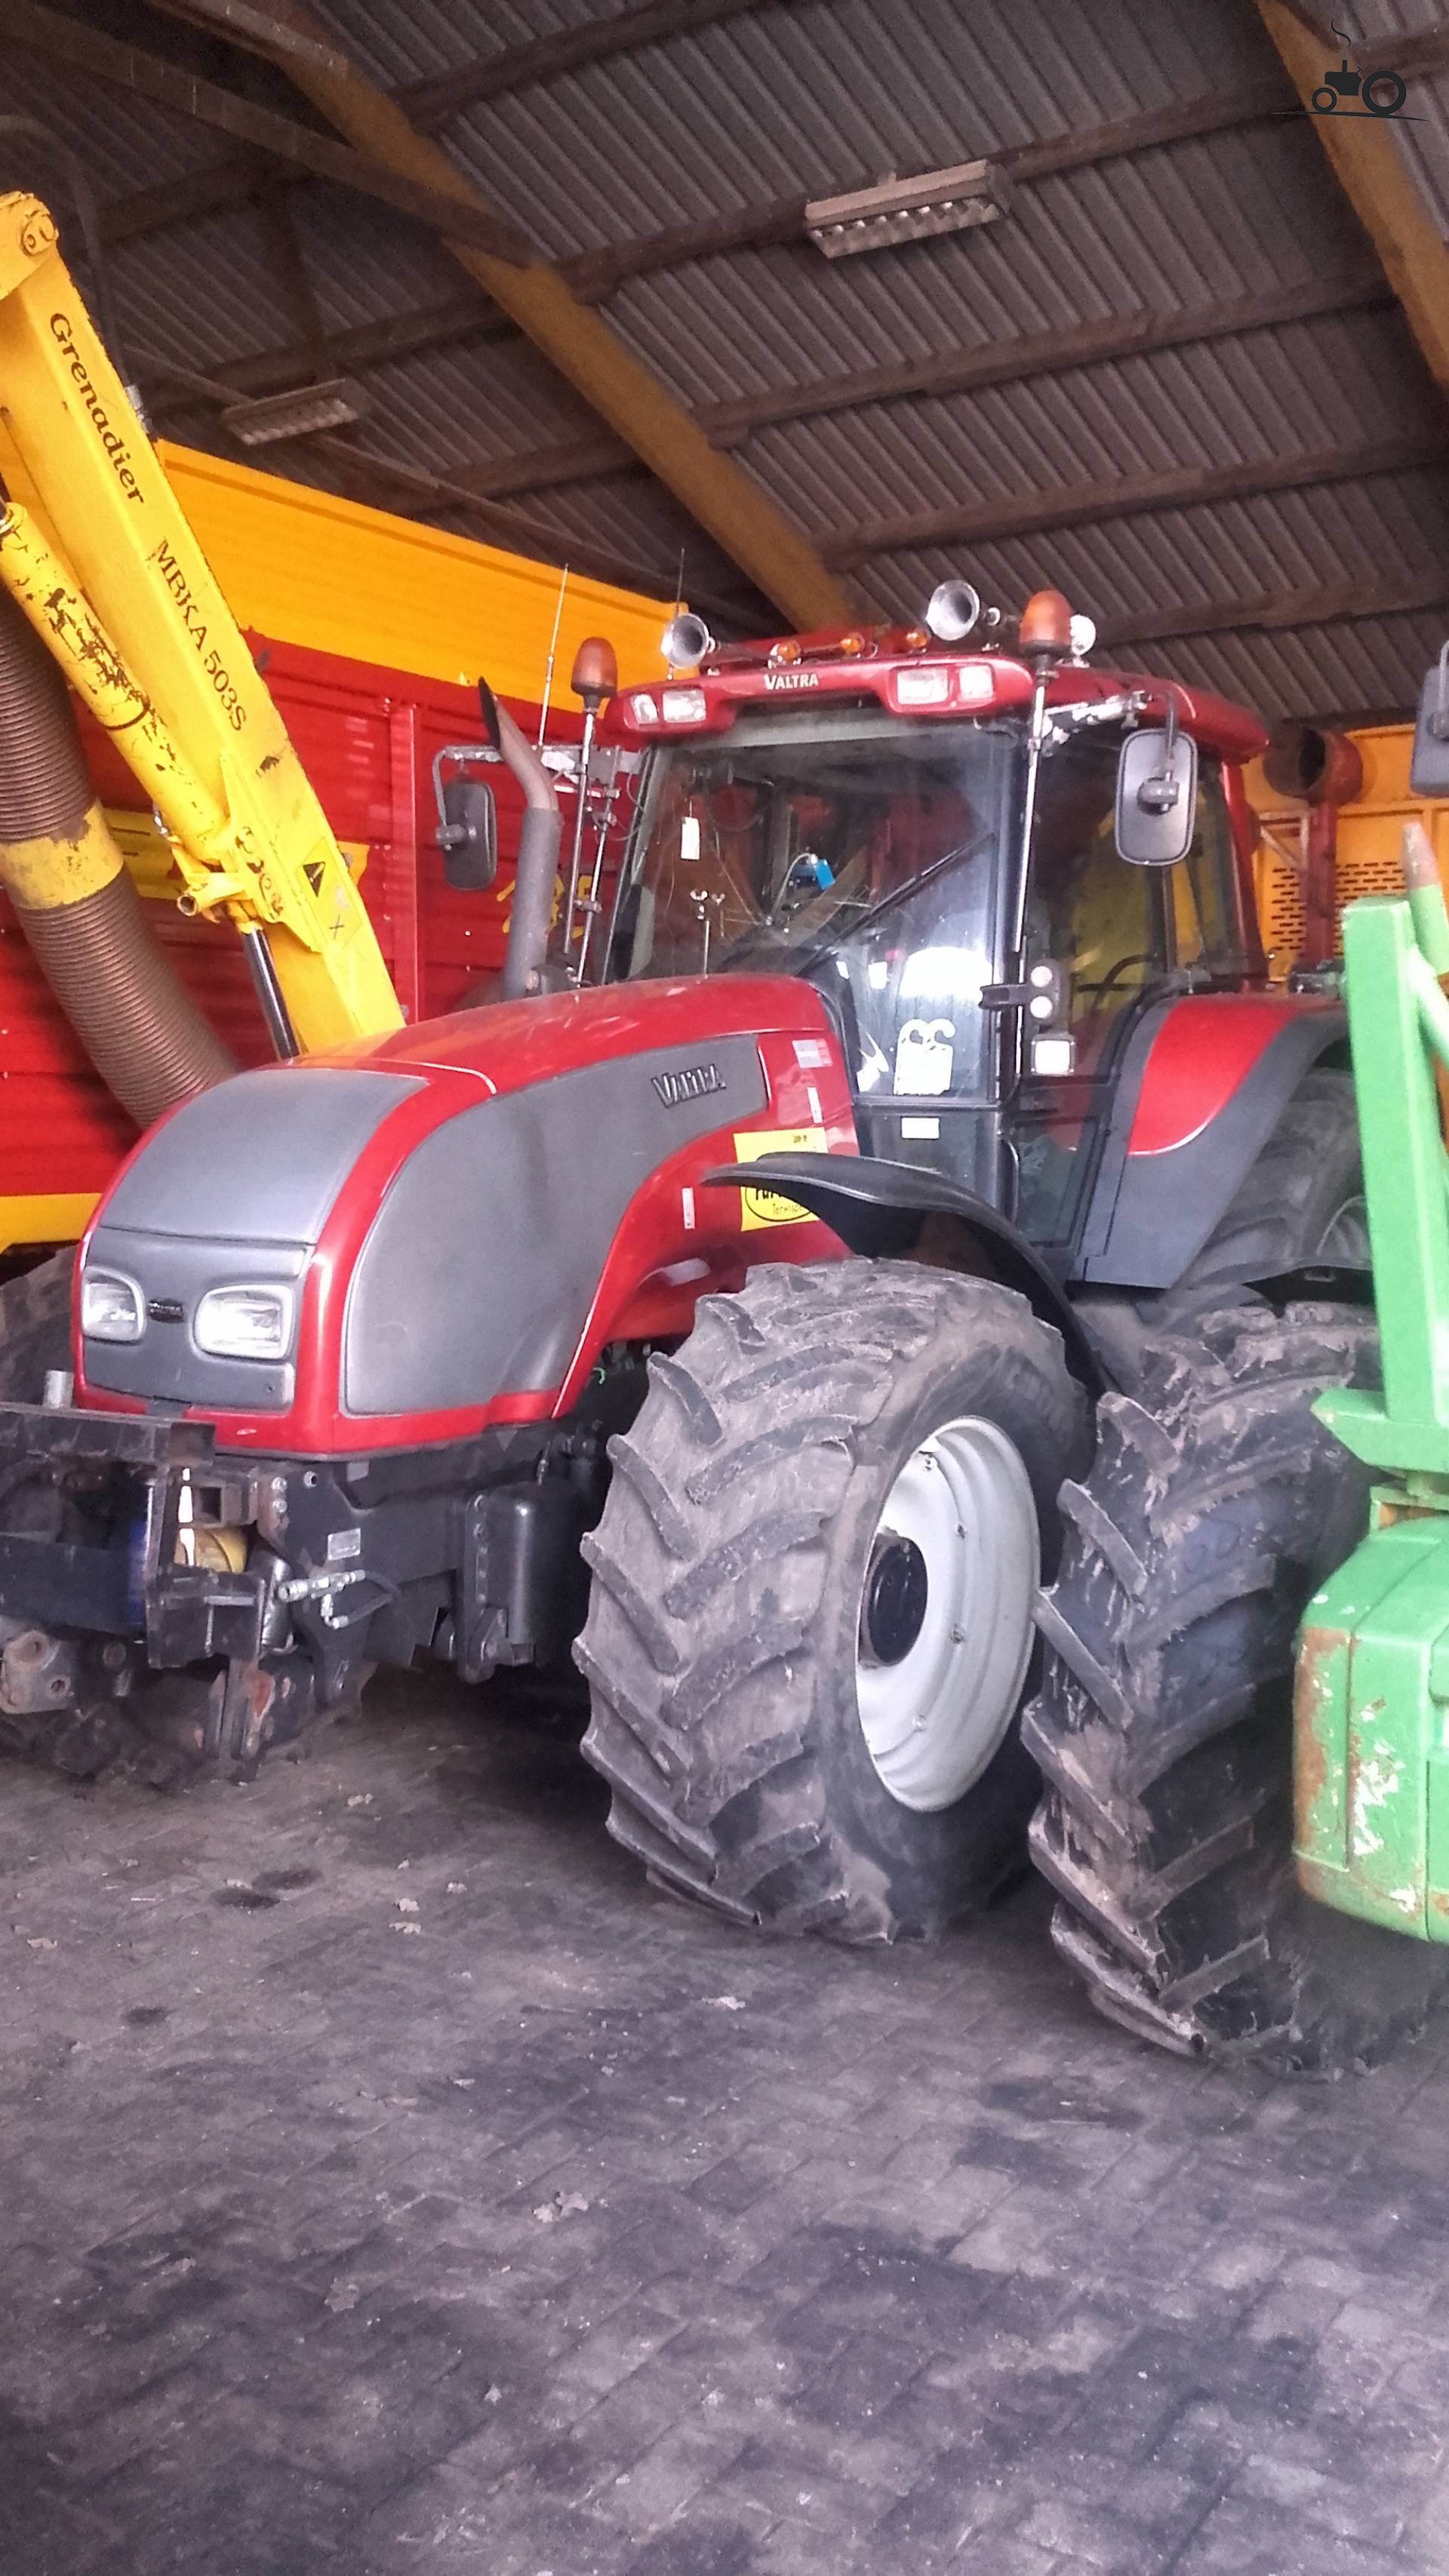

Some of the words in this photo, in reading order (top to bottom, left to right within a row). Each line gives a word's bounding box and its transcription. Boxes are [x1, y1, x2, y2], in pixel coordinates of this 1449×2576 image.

[50, 312, 144, 504] Grenadier
[204, 649, 247, 731] 503S
[763, 672, 819, 691] VALTRA
